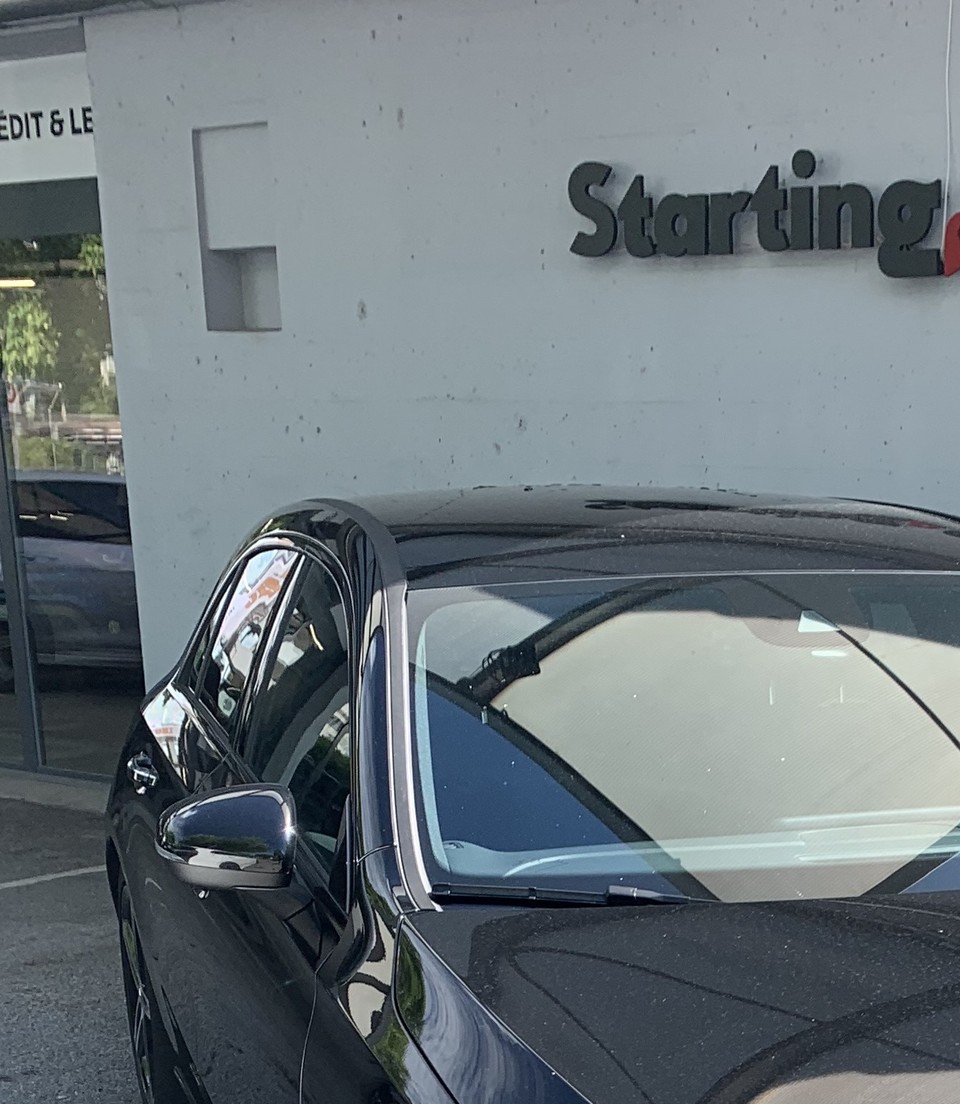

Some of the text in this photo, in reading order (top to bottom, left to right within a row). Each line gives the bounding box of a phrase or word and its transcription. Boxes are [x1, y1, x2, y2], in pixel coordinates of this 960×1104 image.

[50, 109, 65, 137] &
[69, 106, 94, 135] LE
[567, 148, 943, 279] Starting
